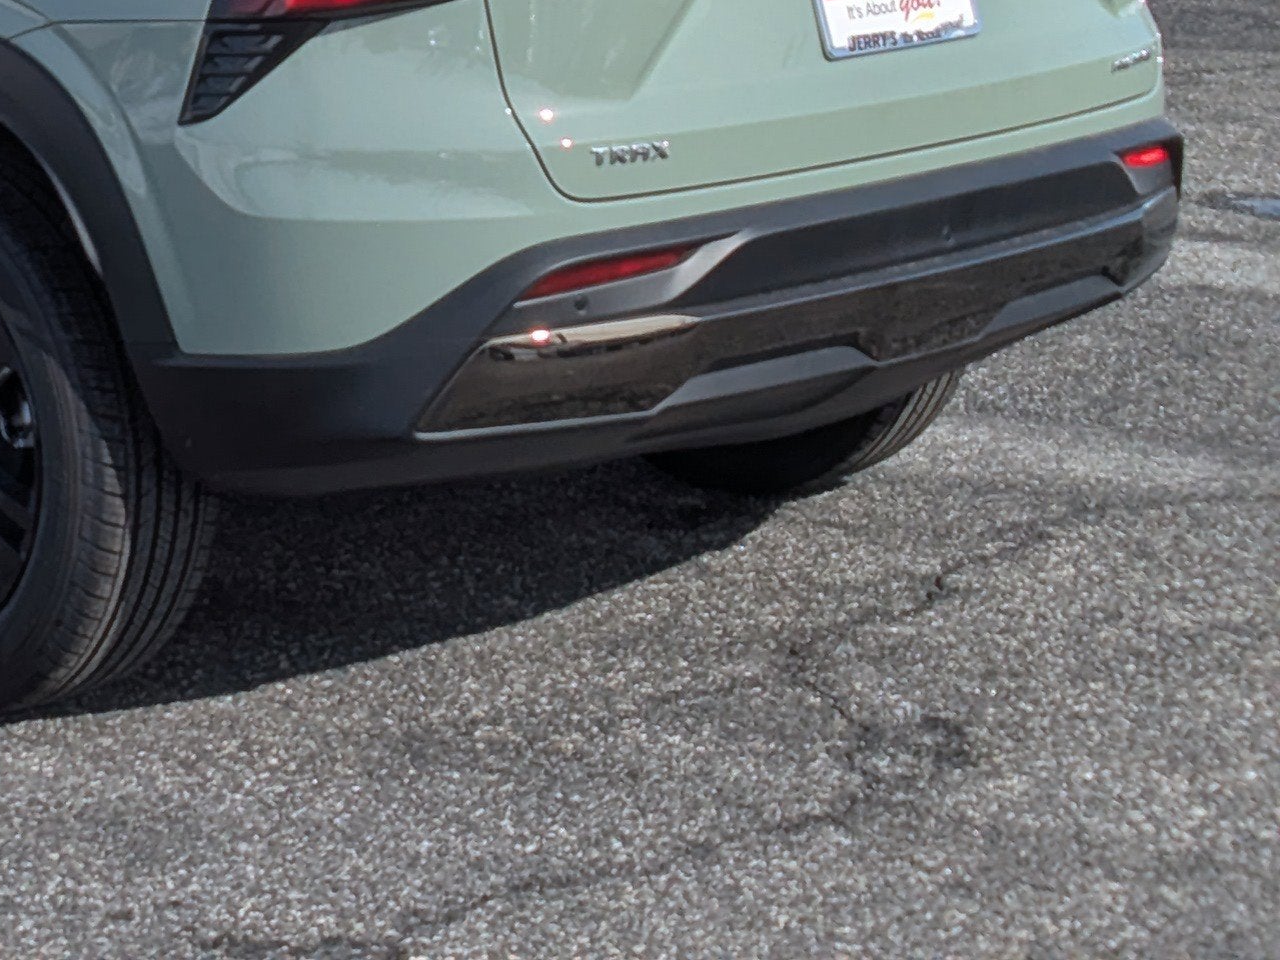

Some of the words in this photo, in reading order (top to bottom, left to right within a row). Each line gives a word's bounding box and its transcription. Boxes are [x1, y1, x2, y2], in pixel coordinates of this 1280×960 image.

[846, 4, 863, 21] It's
[865, 0, 896, 16] About
[590, 141, 670, 167] TRAX
